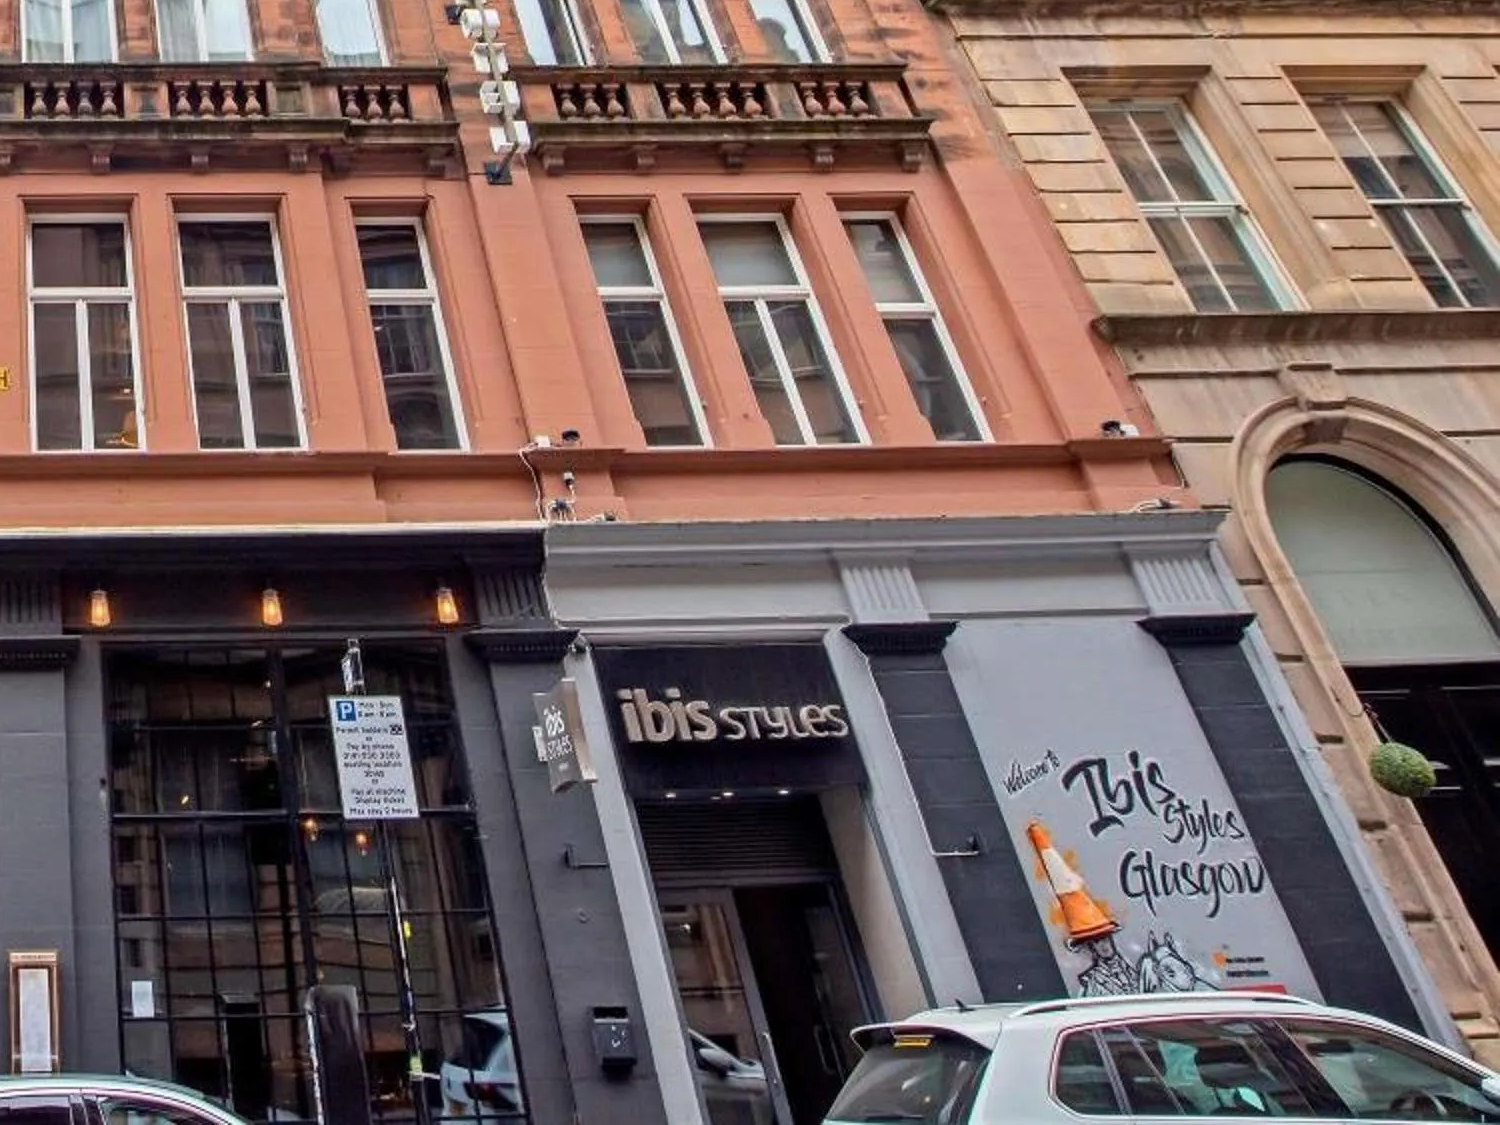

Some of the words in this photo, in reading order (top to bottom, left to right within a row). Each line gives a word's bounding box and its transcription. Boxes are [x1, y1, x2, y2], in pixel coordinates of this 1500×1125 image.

[340, 703, 352, 719] P
[616, 687, 717, 742] ibis
[1062, 750, 1177, 837] Ibis
[1162, 798, 1245, 855] Styles
[1119, 850, 1265, 918] Glasgow
